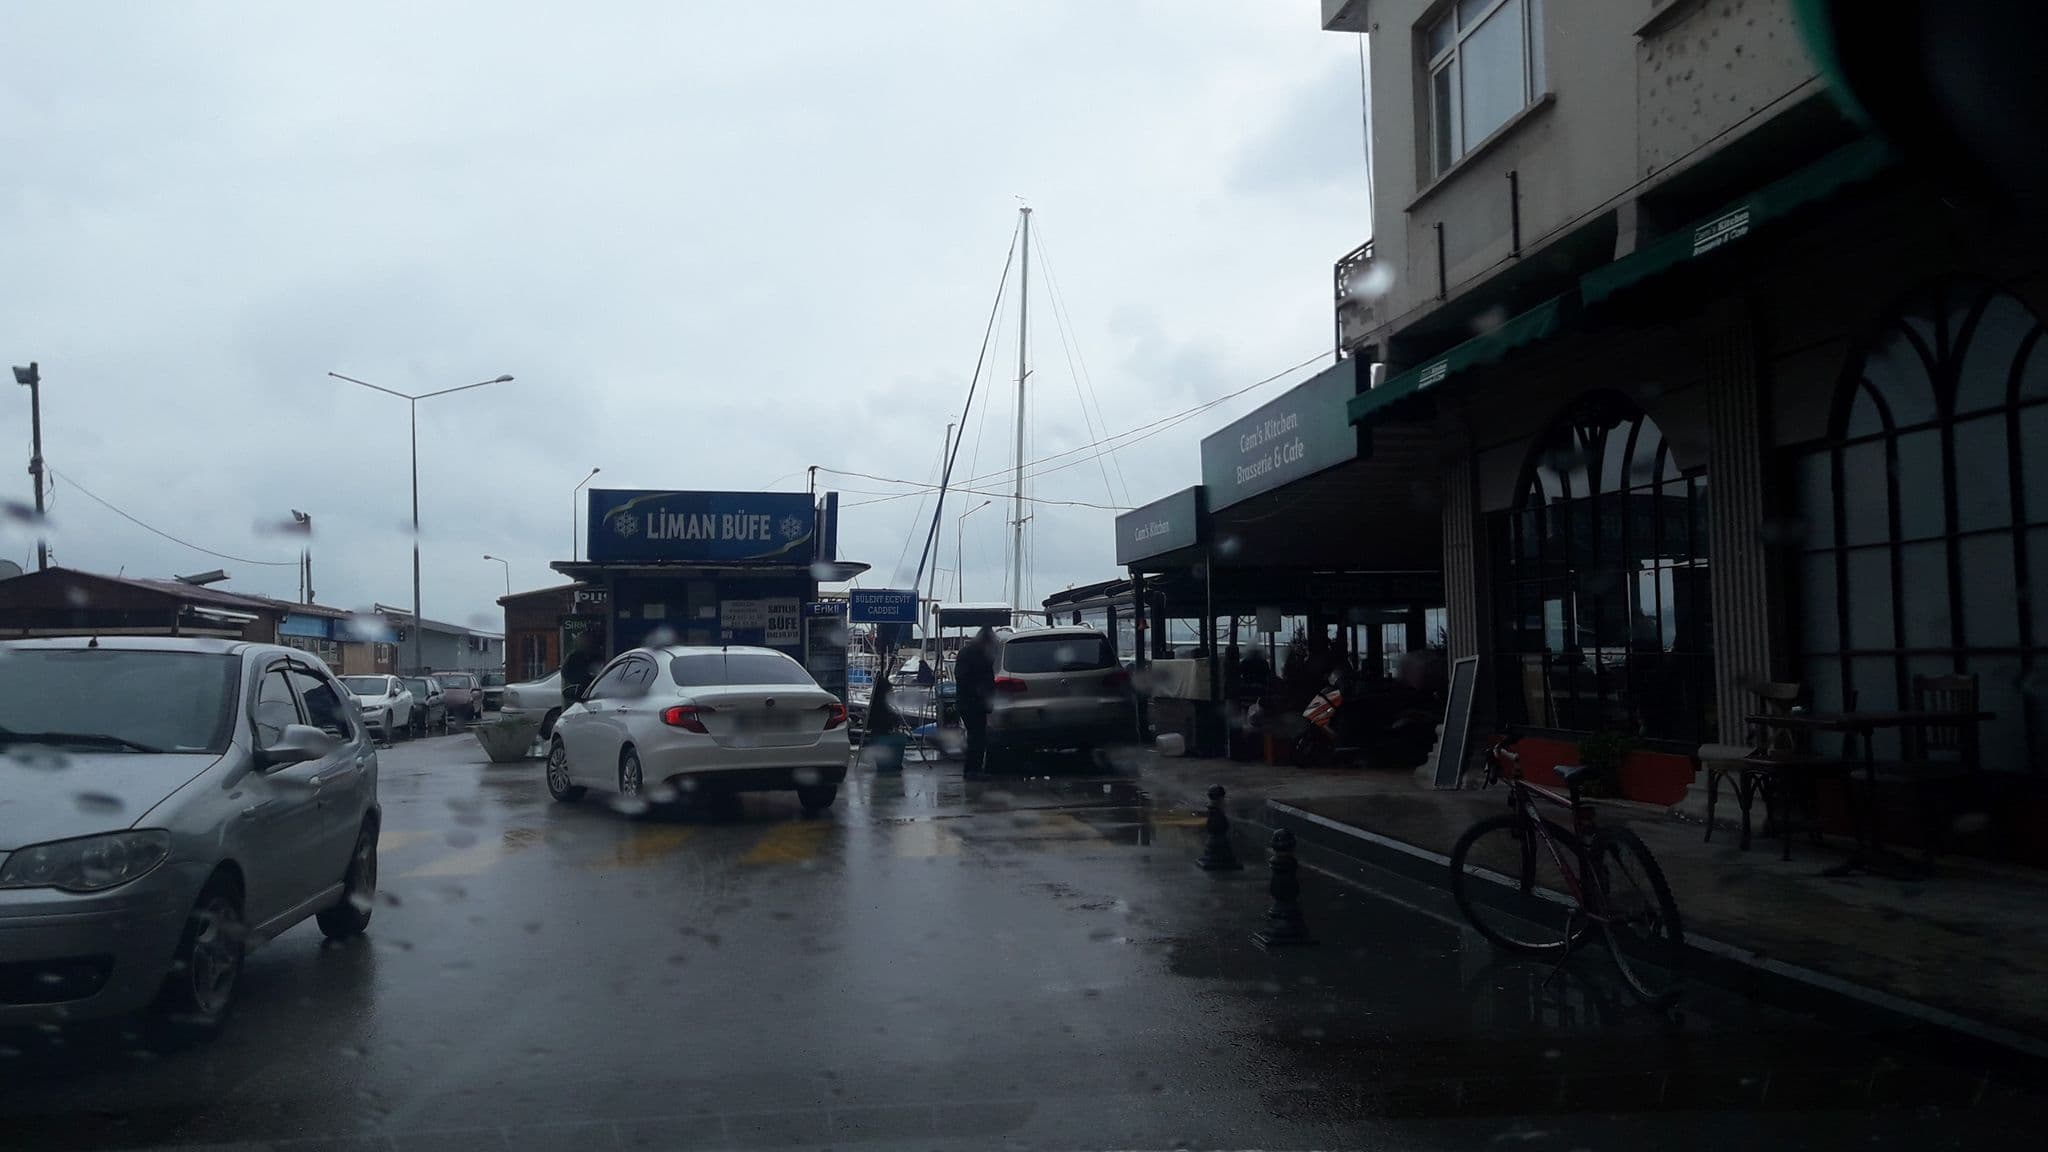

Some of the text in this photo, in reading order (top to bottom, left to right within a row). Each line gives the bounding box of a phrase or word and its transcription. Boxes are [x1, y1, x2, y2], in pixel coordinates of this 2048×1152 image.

[1240, 412, 1298, 454] Cem's Kitchen
[1236, 436, 1305, 485] Brasserie & Cafe
[646, 507, 771, 541] LİMAN BÜFE
[855, 594, 883, 605] BÜLENT
[814, 604, 839, 615] Erikli
[867, 605, 900, 616] CADDESİ
[768, 616, 798, 631] BÜFE
